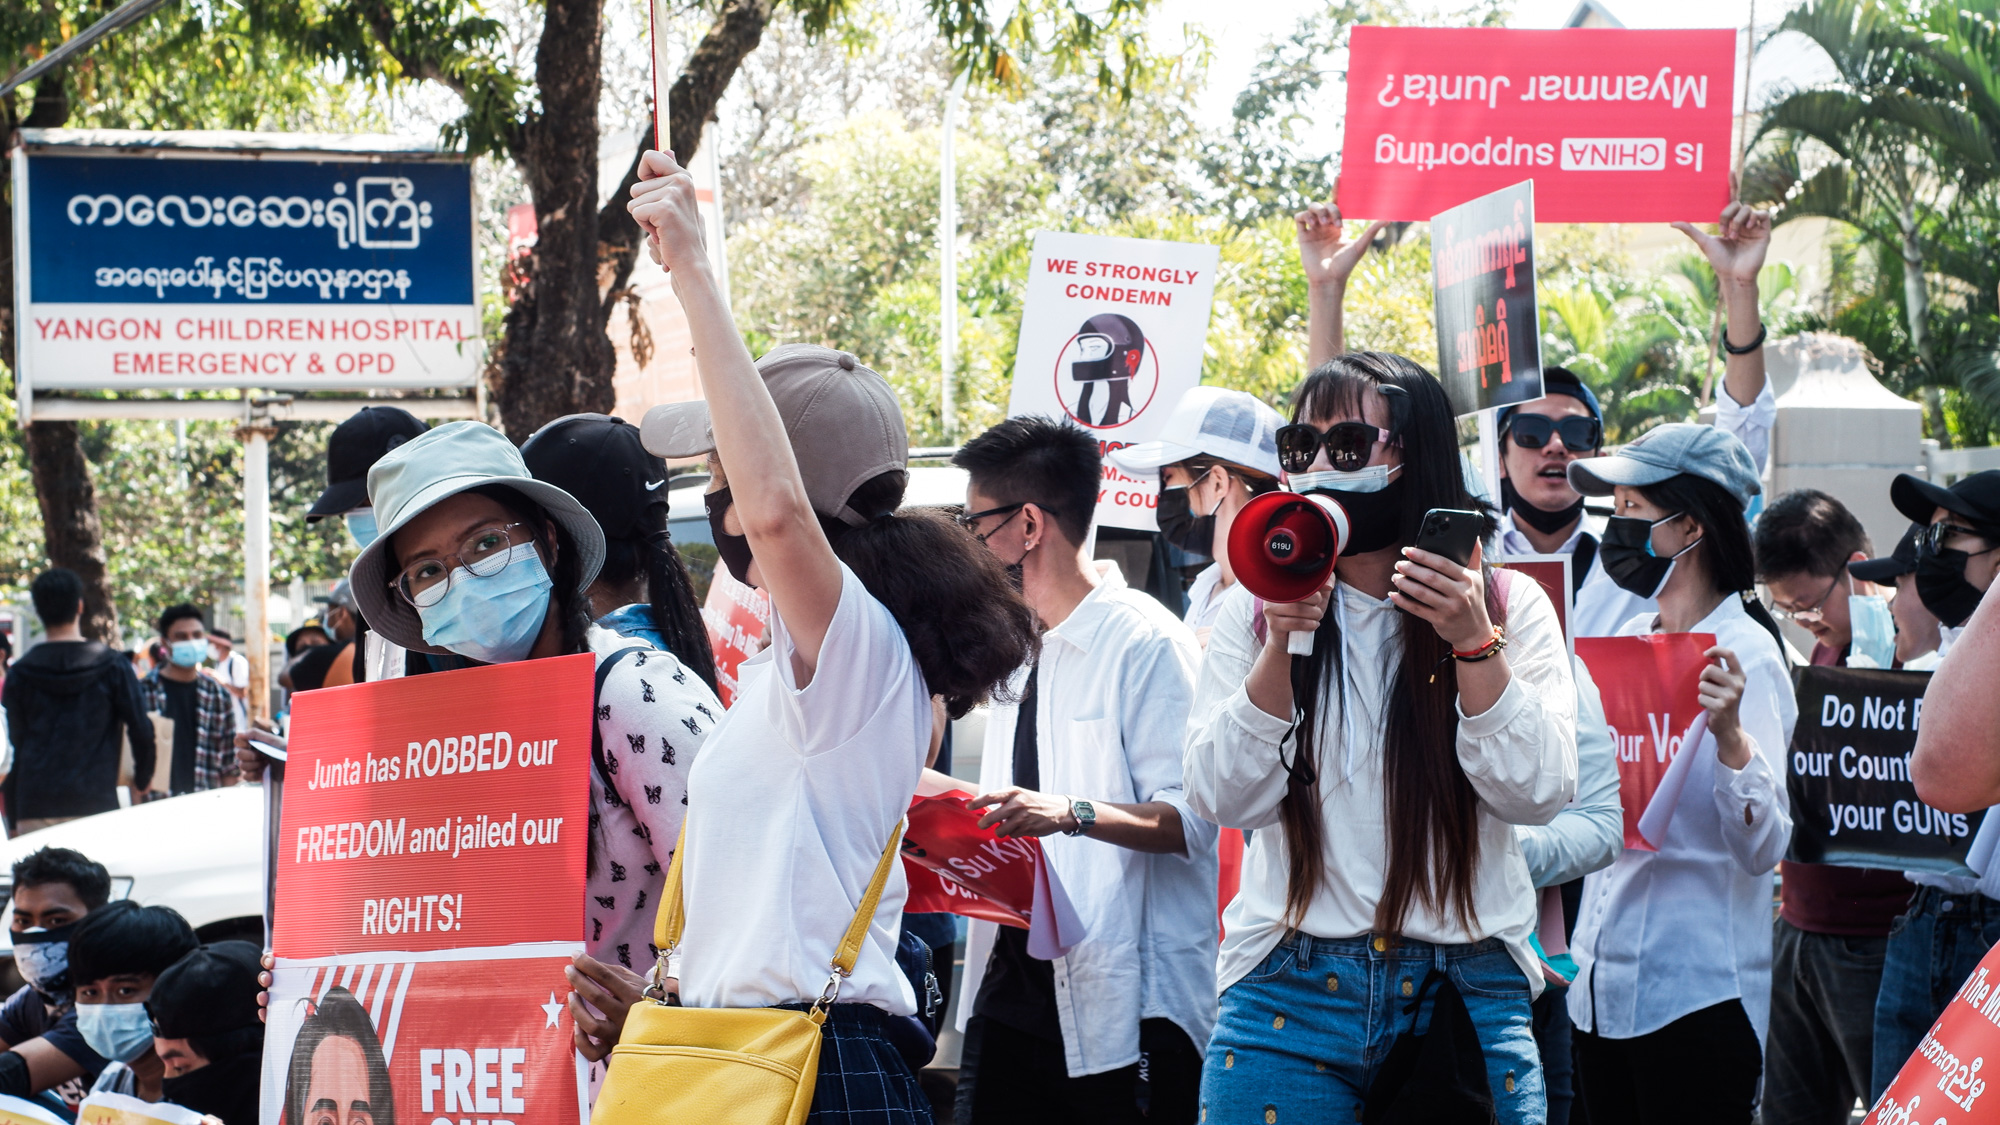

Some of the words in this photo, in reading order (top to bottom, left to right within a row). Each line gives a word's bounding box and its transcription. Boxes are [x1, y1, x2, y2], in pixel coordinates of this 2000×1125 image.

[1377, 73, 1510, 108] Junta?
[1520, 66, 1708, 109] Myanmar
[1375, 134, 1555, 171] supporting
[1569, 143, 1660, 166] CHINA
[1675, 143, 1703, 172] Is
[1046, 258, 1078, 275] WE
[1085, 262, 1199, 285] STRONGLY
[1065, 284, 1172, 306] CONDEMN
[36, 318, 162, 341] YANGON
[176, 318, 325, 341] CHILDREN
[332, 319, 468, 341] HOSPITAL
[113, 353, 296, 375] EMERGENCY
[307, 353, 325, 374] &
[336, 353, 396, 374] OPD
[1272, 542, 1291, 550] 619U
[1821, 694, 1855, 728] Do
[1862, 696, 1906, 730] Not
[308, 757, 361, 790] Junta
[365, 752, 400, 783] has
[405, 731, 512, 780] ROBBED
[517, 738, 558, 768] our
[1794, 750, 1833, 777] our
[1829, 803, 1886, 836] your
[296, 817, 406, 863] FREEDOM
[409, 817, 449, 853] and
[452, 813, 517, 858] jailed
[521, 817, 563, 845] our
[948, 855, 997, 879] Su
[361, 893, 463, 935] RIGHTS!
[1963, 966, 1990, 1009] The
[420, 1048, 525, 1114] FREE
